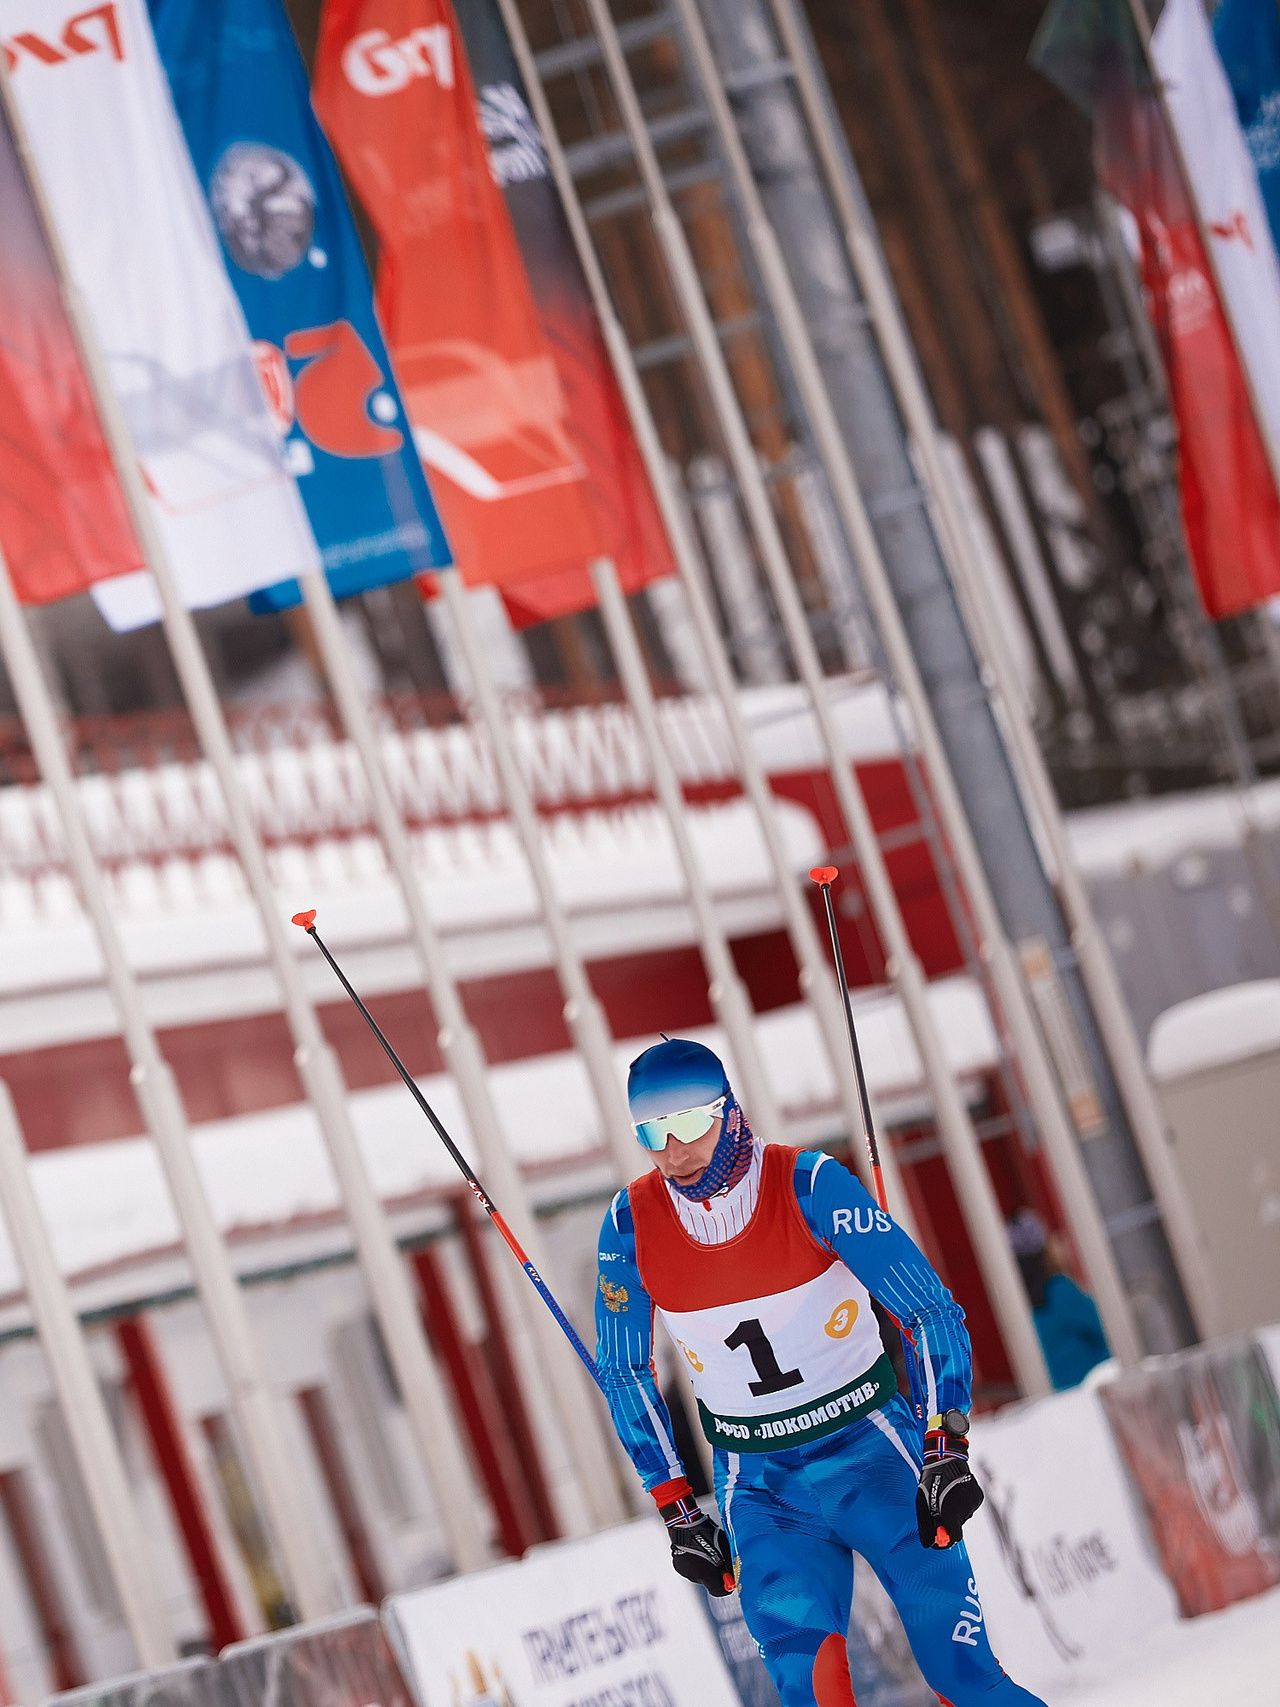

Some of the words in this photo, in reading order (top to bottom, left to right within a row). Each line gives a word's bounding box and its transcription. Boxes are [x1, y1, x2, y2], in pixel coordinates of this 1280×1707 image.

[832, 1207, 892, 1235] RUS
[723, 1318, 805, 1397] 1
[714, 1417, 750, 1440] РФСО
[754, 1381, 881, 1440] «ЛОКОМОТИВ»
